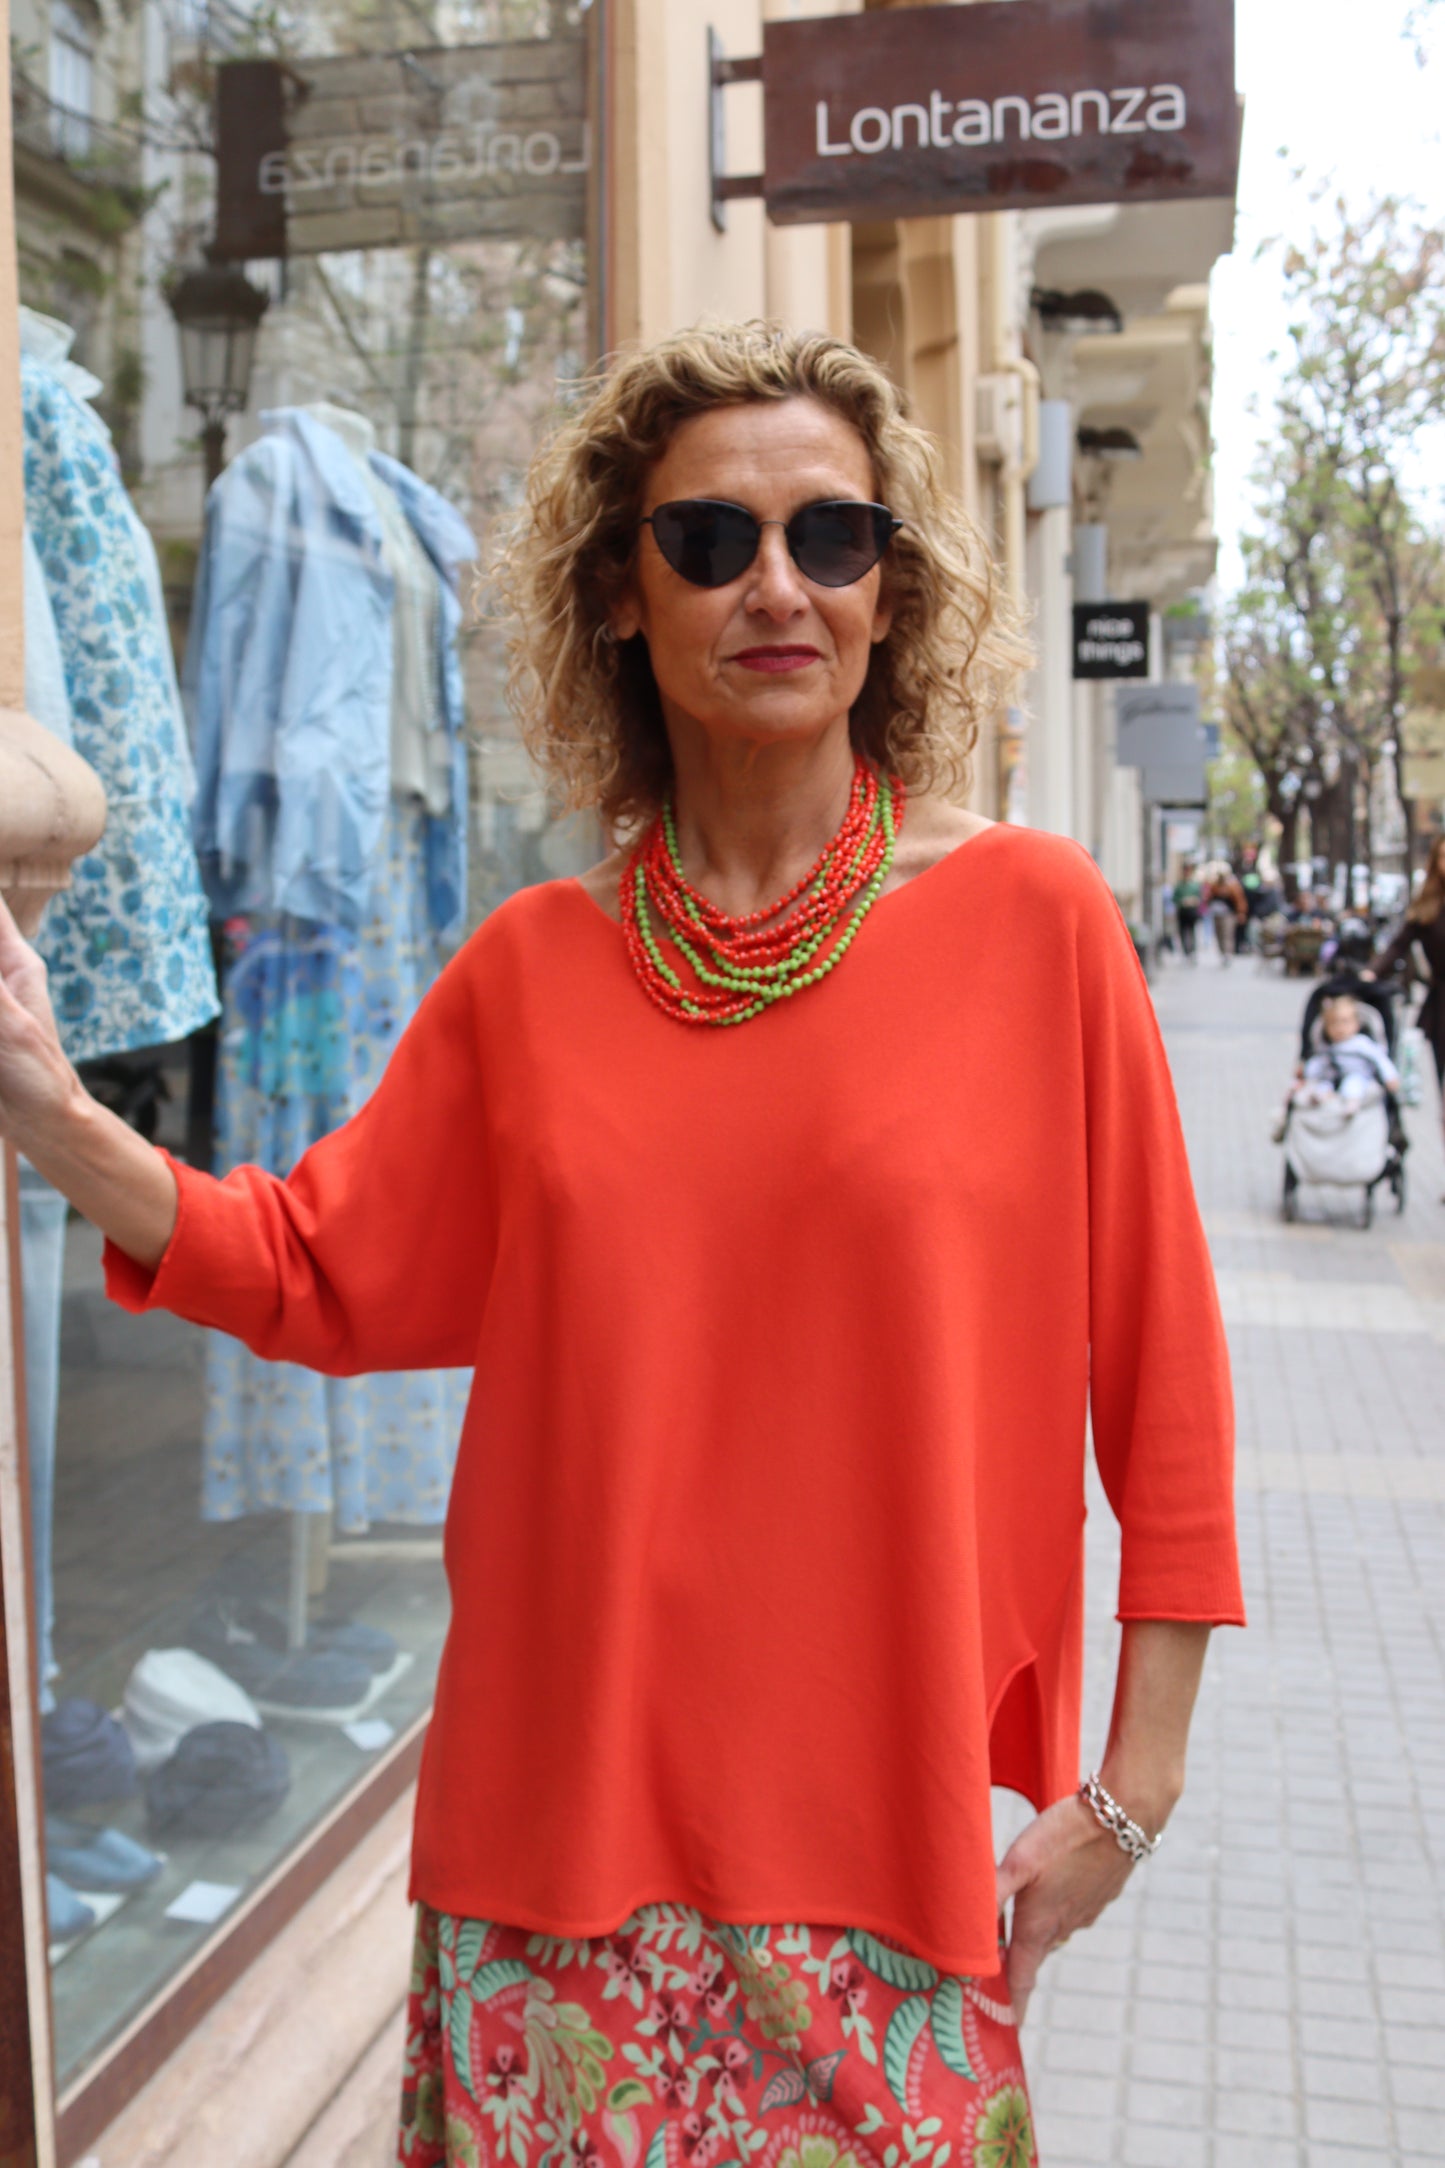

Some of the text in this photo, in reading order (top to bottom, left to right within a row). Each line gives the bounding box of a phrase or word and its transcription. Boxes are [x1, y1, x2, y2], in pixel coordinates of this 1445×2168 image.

[816, 84, 1187, 156] Lontananza
[1087, 616, 1134, 638] nice
[1078, 640, 1144, 666] things
